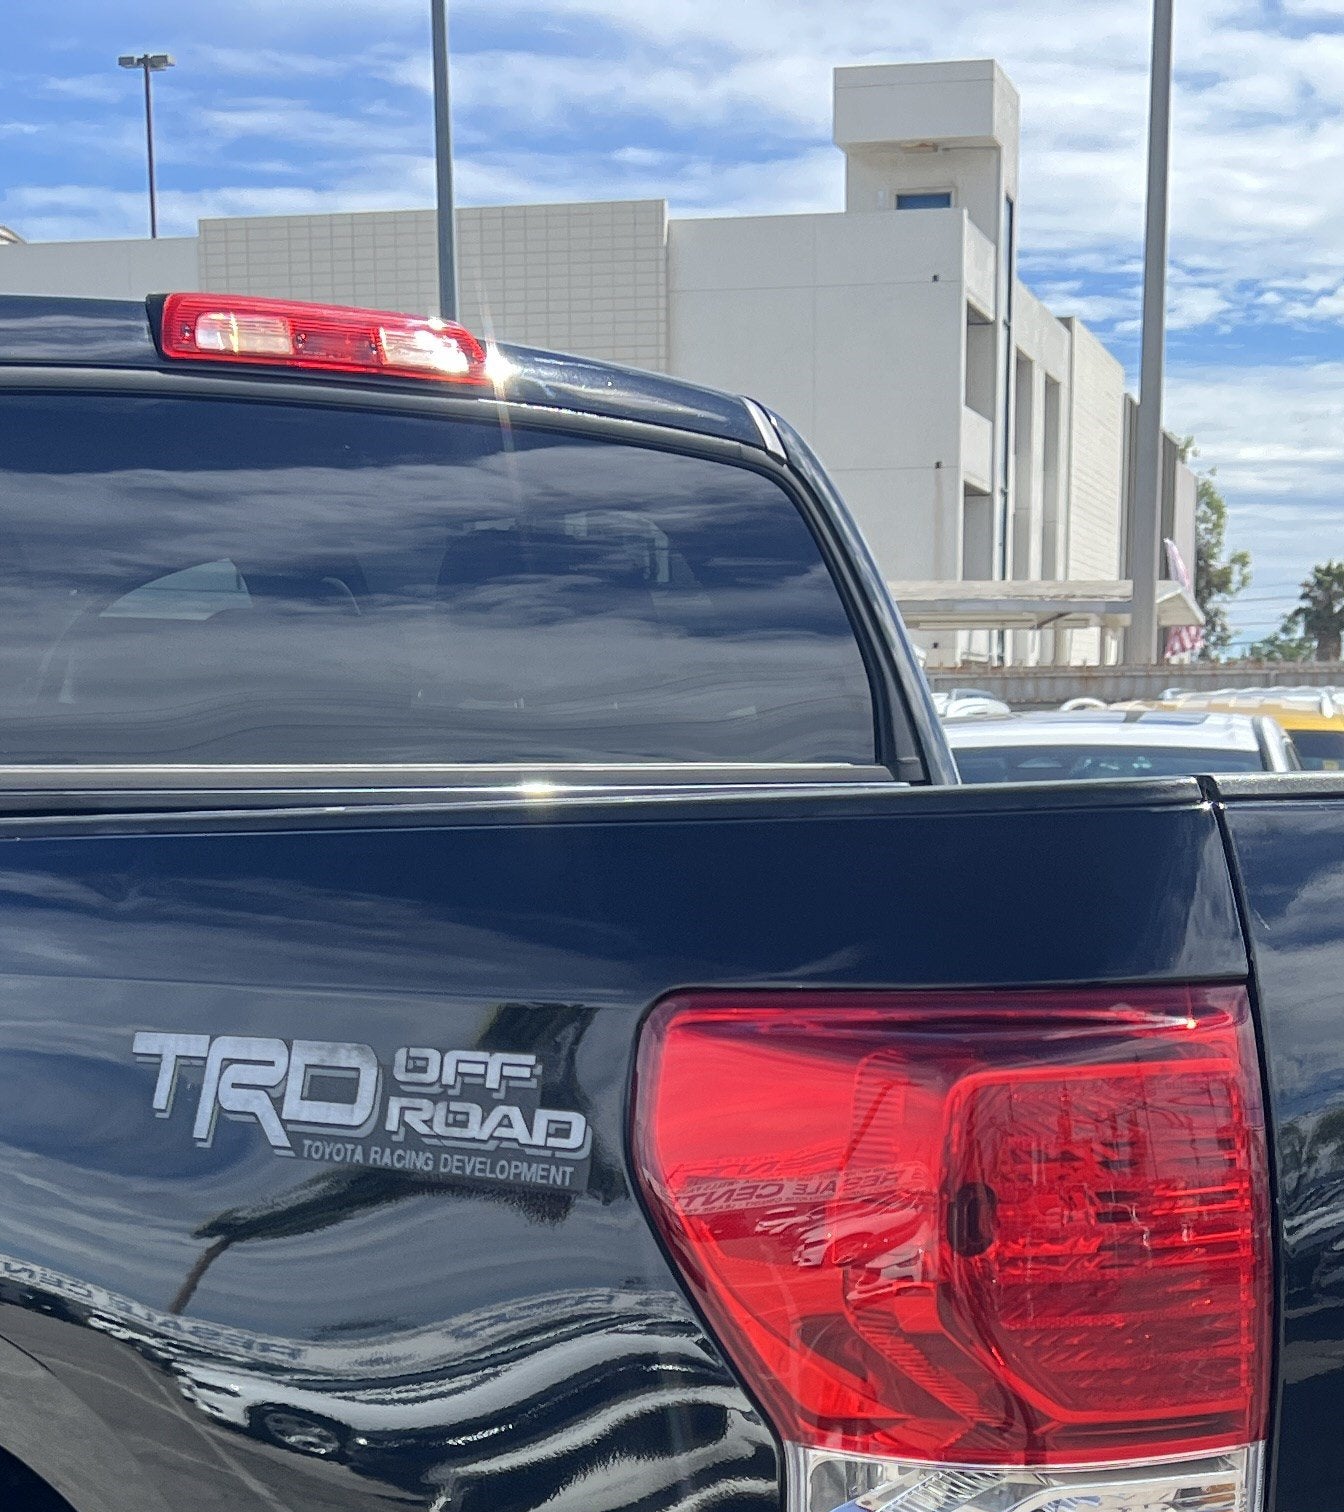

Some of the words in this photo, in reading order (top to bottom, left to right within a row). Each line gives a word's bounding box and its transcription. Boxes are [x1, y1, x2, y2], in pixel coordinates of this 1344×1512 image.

[132, 1030, 383, 1158] TRD
[392, 1047, 542, 1097] OFF
[385, 1096, 592, 1160] ROAD
[302, 1138, 364, 1165] TOYOTA
[369, 1145, 434, 1172] RACING
[440, 1152, 575, 1188] DEVELOPMENT
